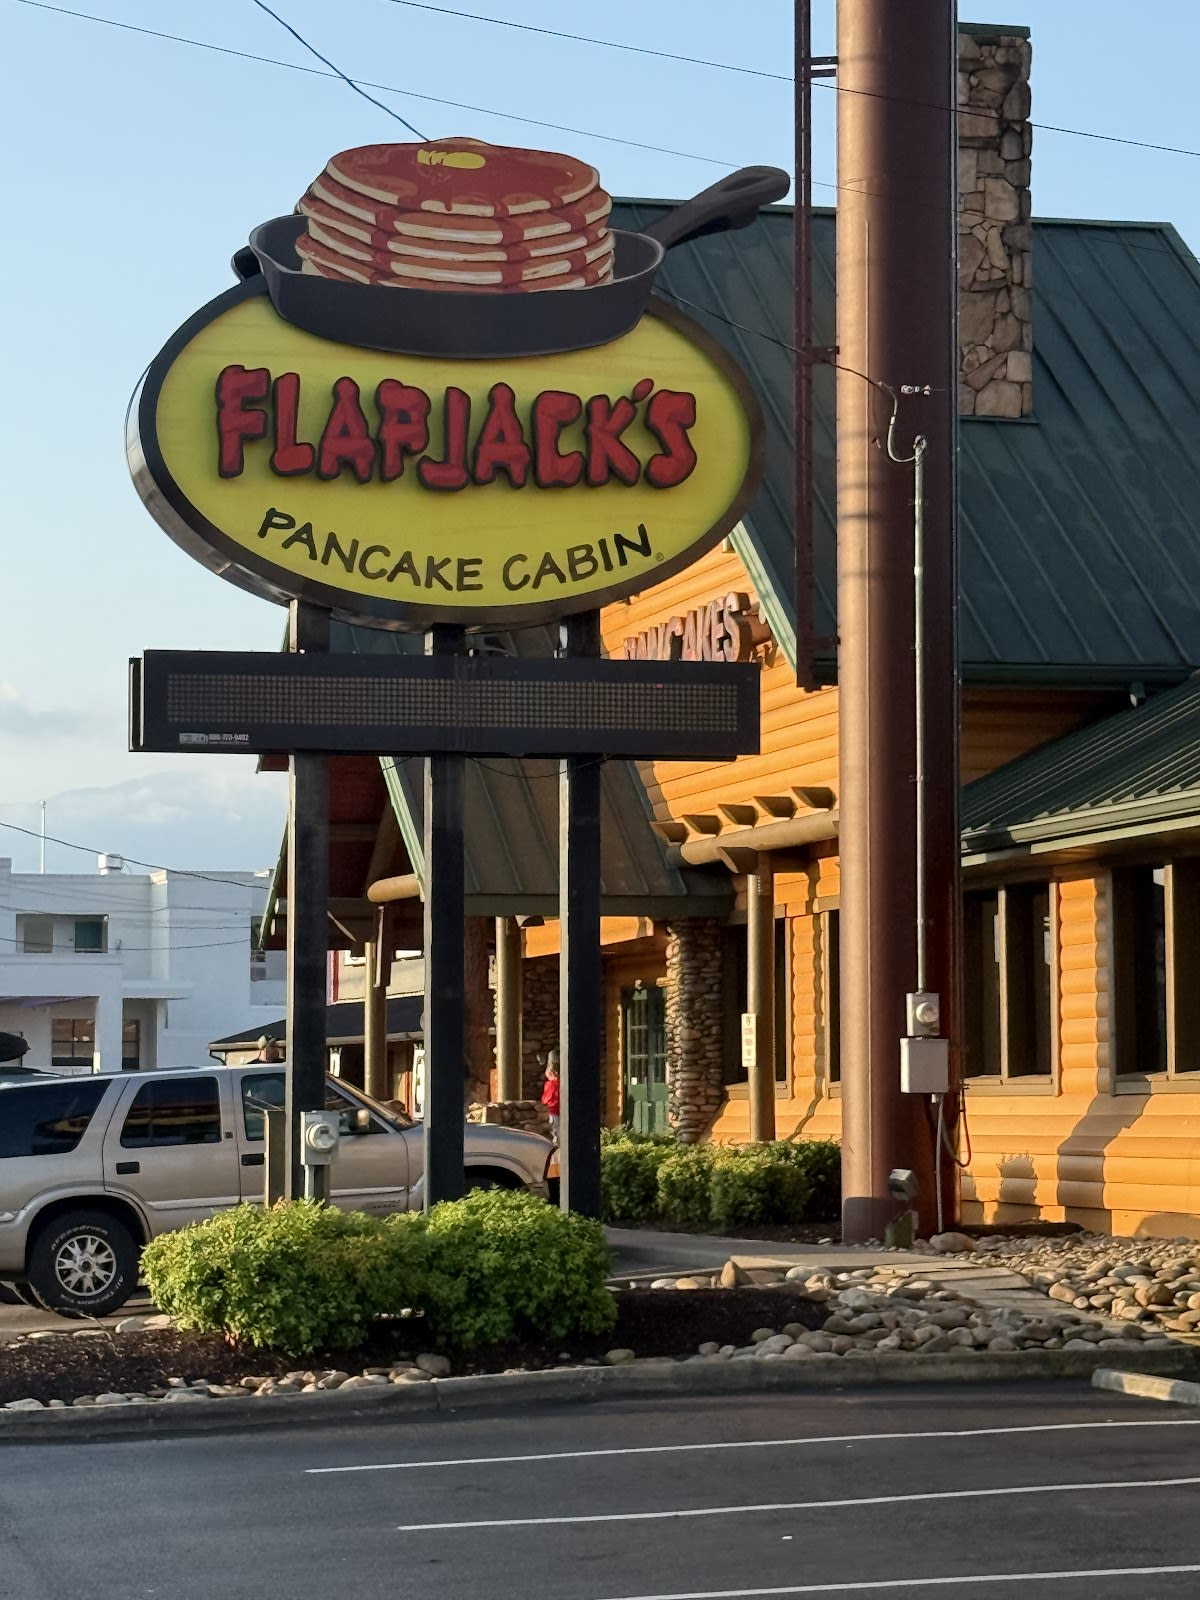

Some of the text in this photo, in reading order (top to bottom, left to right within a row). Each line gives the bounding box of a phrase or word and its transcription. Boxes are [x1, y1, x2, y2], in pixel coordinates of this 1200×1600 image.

[215, 364, 697, 491] FLAPJACK'S
[257, 507, 652, 592] PANCAKE CABIN
